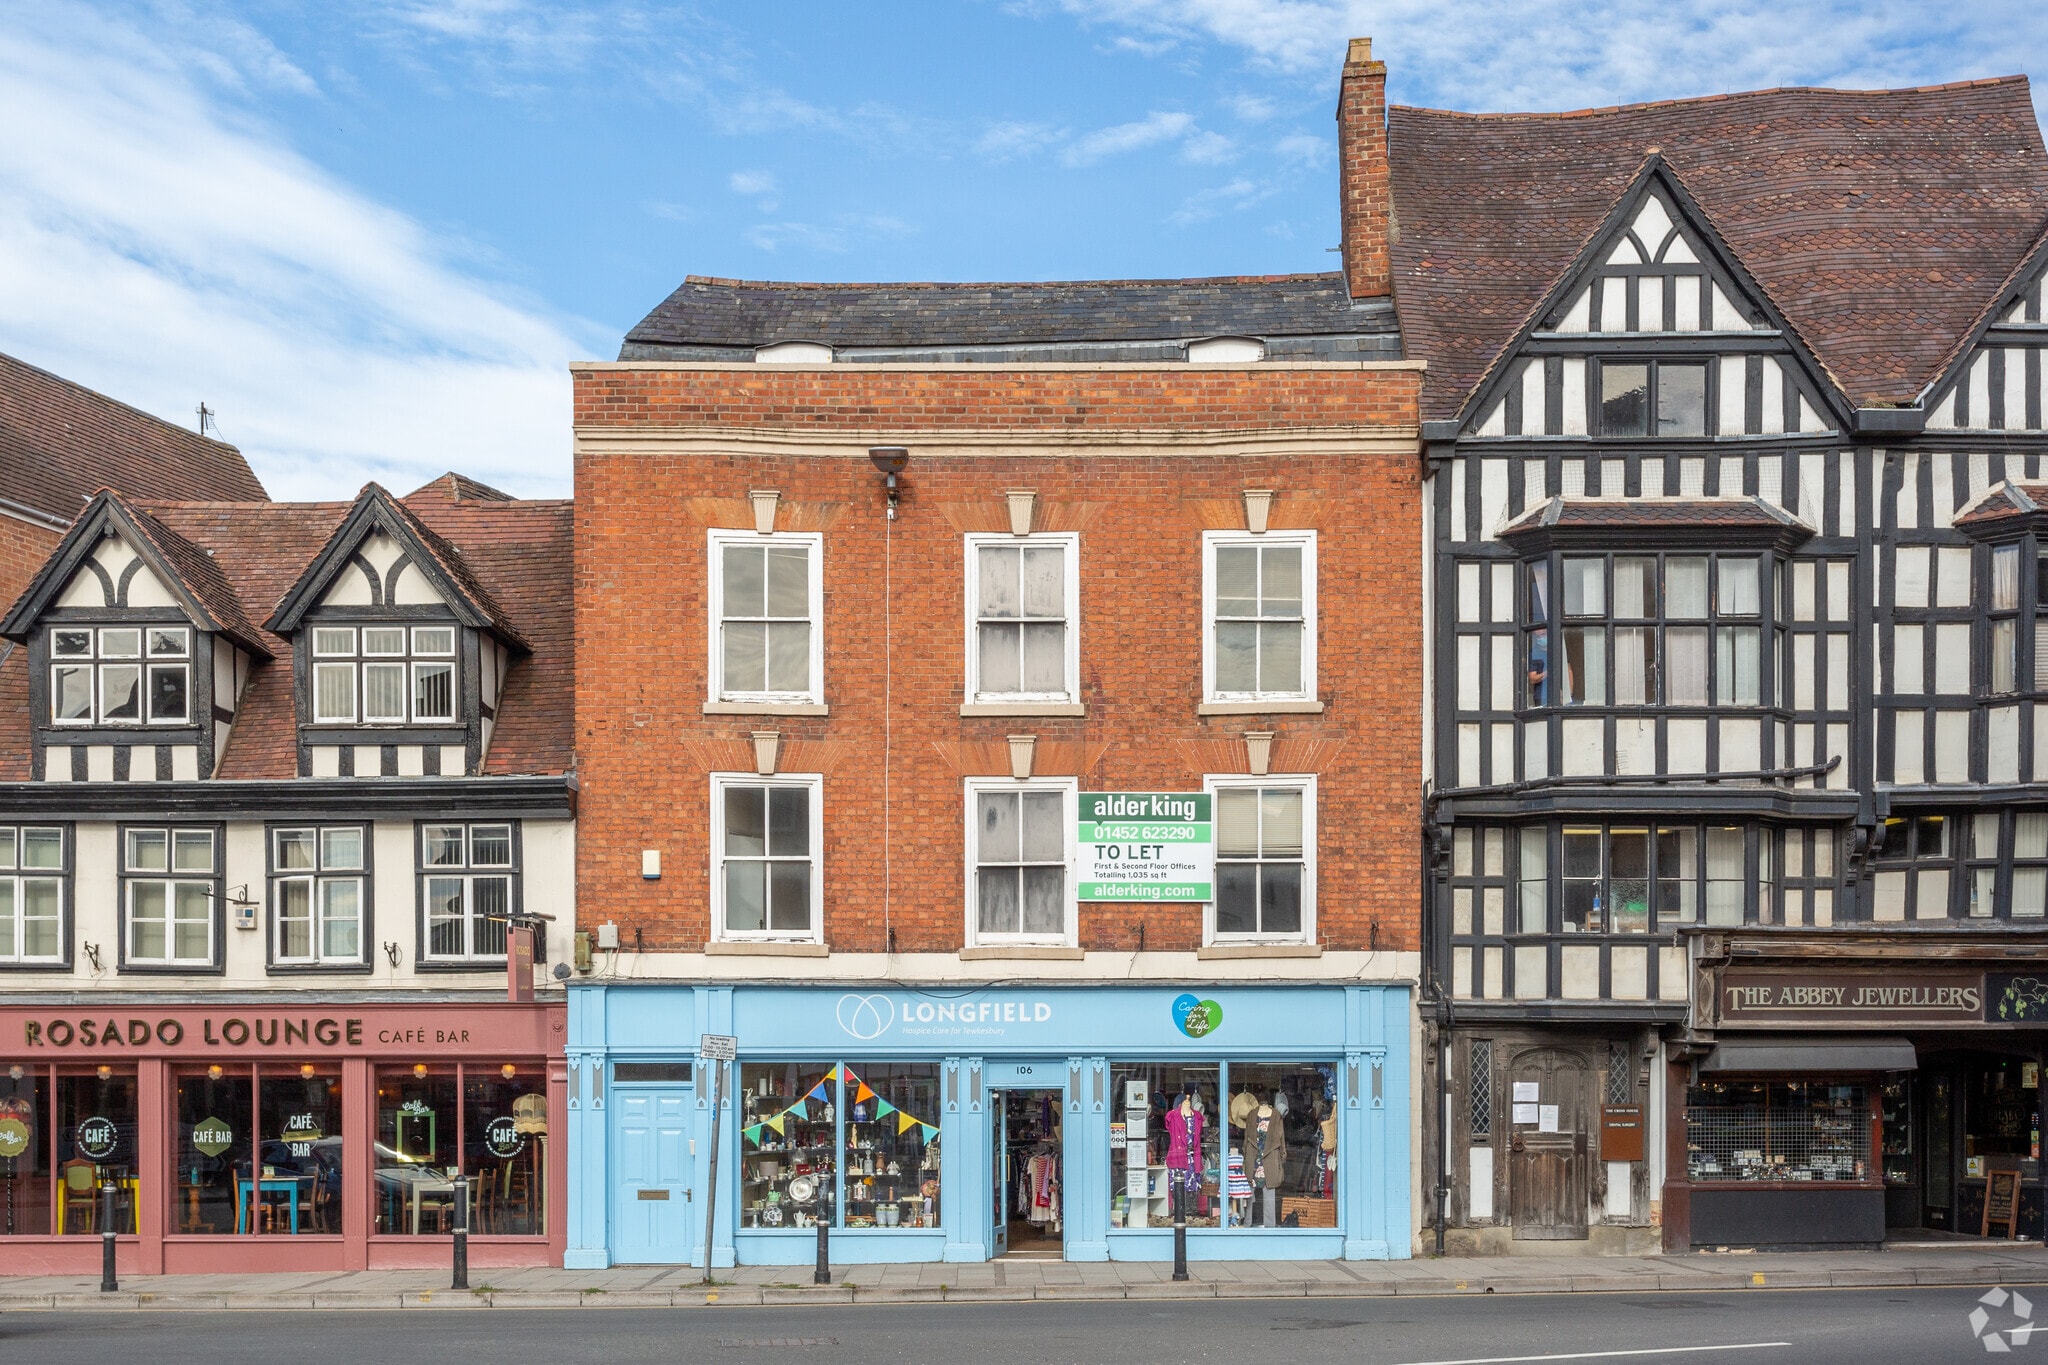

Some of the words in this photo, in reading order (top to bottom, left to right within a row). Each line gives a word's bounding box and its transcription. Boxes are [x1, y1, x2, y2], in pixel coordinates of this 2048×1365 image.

[1094, 795, 1149, 816] alder
[1151, 795, 1196, 821] king
[1094, 826, 1139, 840] 01452
[1141, 826, 1196, 840] 623290
[1094, 845, 1120, 860] TO
[1128, 845, 1164, 860] LET
[1094, 872, 1126, 880] Totalling
[1128, 872, 1149, 880] 1,035
[1150, 873, 1159, 881] sq
[1094, 884, 1196, 899] alderking.com
[1725, 986, 1773, 1011] THE
[1778, 987, 1846, 1006] ABBEY
[1852, 986, 1981, 1012] JEWELLERS
[902, 1002, 1052, 1023] LONGFIELD
[1178, 1001, 1212, 1017] Caring
[1185, 1011, 1201, 1022] for
[25, 1018, 184, 1046] ROSADO
[204, 1018, 363, 1046] LOUNGE
[378, 1026, 426, 1044] CAFÉ
[436, 1030, 471, 1043] BAR
[902, 1027, 931, 1036] Hospice
[932, 1027, 949, 1035] Care
[950, 1027, 961, 1037] for
[963, 1027, 1006, 1037] Tewkesbury
[1187, 1019, 1210, 1035] Life
[1016, 1066, 1033, 1075] 106
[290, 1112, 312, 1129] CAFÉ
[85, 1125, 110, 1143] CAFÉ
[193, 1128, 214, 1143] CAFÉ
[215, 1131, 232, 1143] BAR
[493, 1126, 518, 1143] CAFÉ
[292, 1143, 310, 1157] BAR
